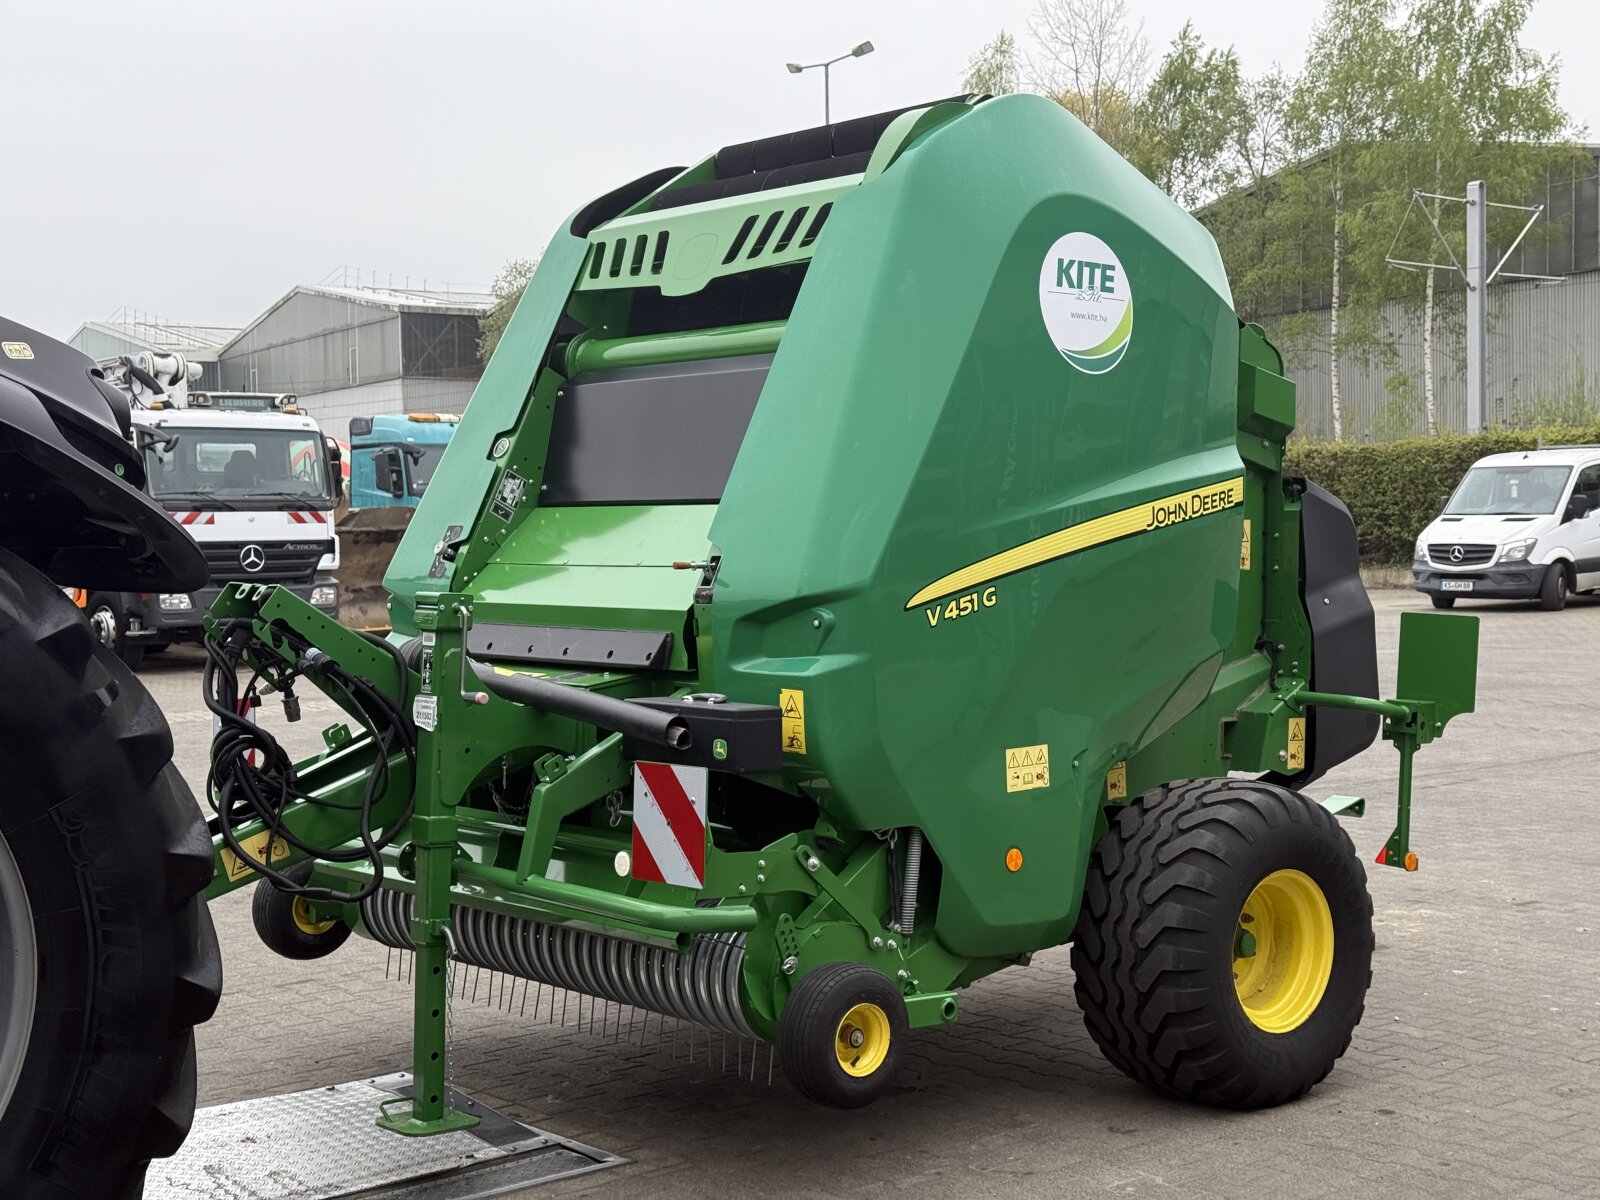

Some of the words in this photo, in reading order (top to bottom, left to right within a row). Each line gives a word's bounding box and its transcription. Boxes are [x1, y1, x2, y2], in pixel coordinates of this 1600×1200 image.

[1056, 258, 1116, 293] KITE
[1070, 311, 1108, 322] www.kite.hu
[1146, 501, 1188, 529] JOHN
[1191, 488, 1234, 517] DEERE
[925, 605, 942, 628] V
[944, 592, 979, 621] 451
[982, 586, 998, 607] G
